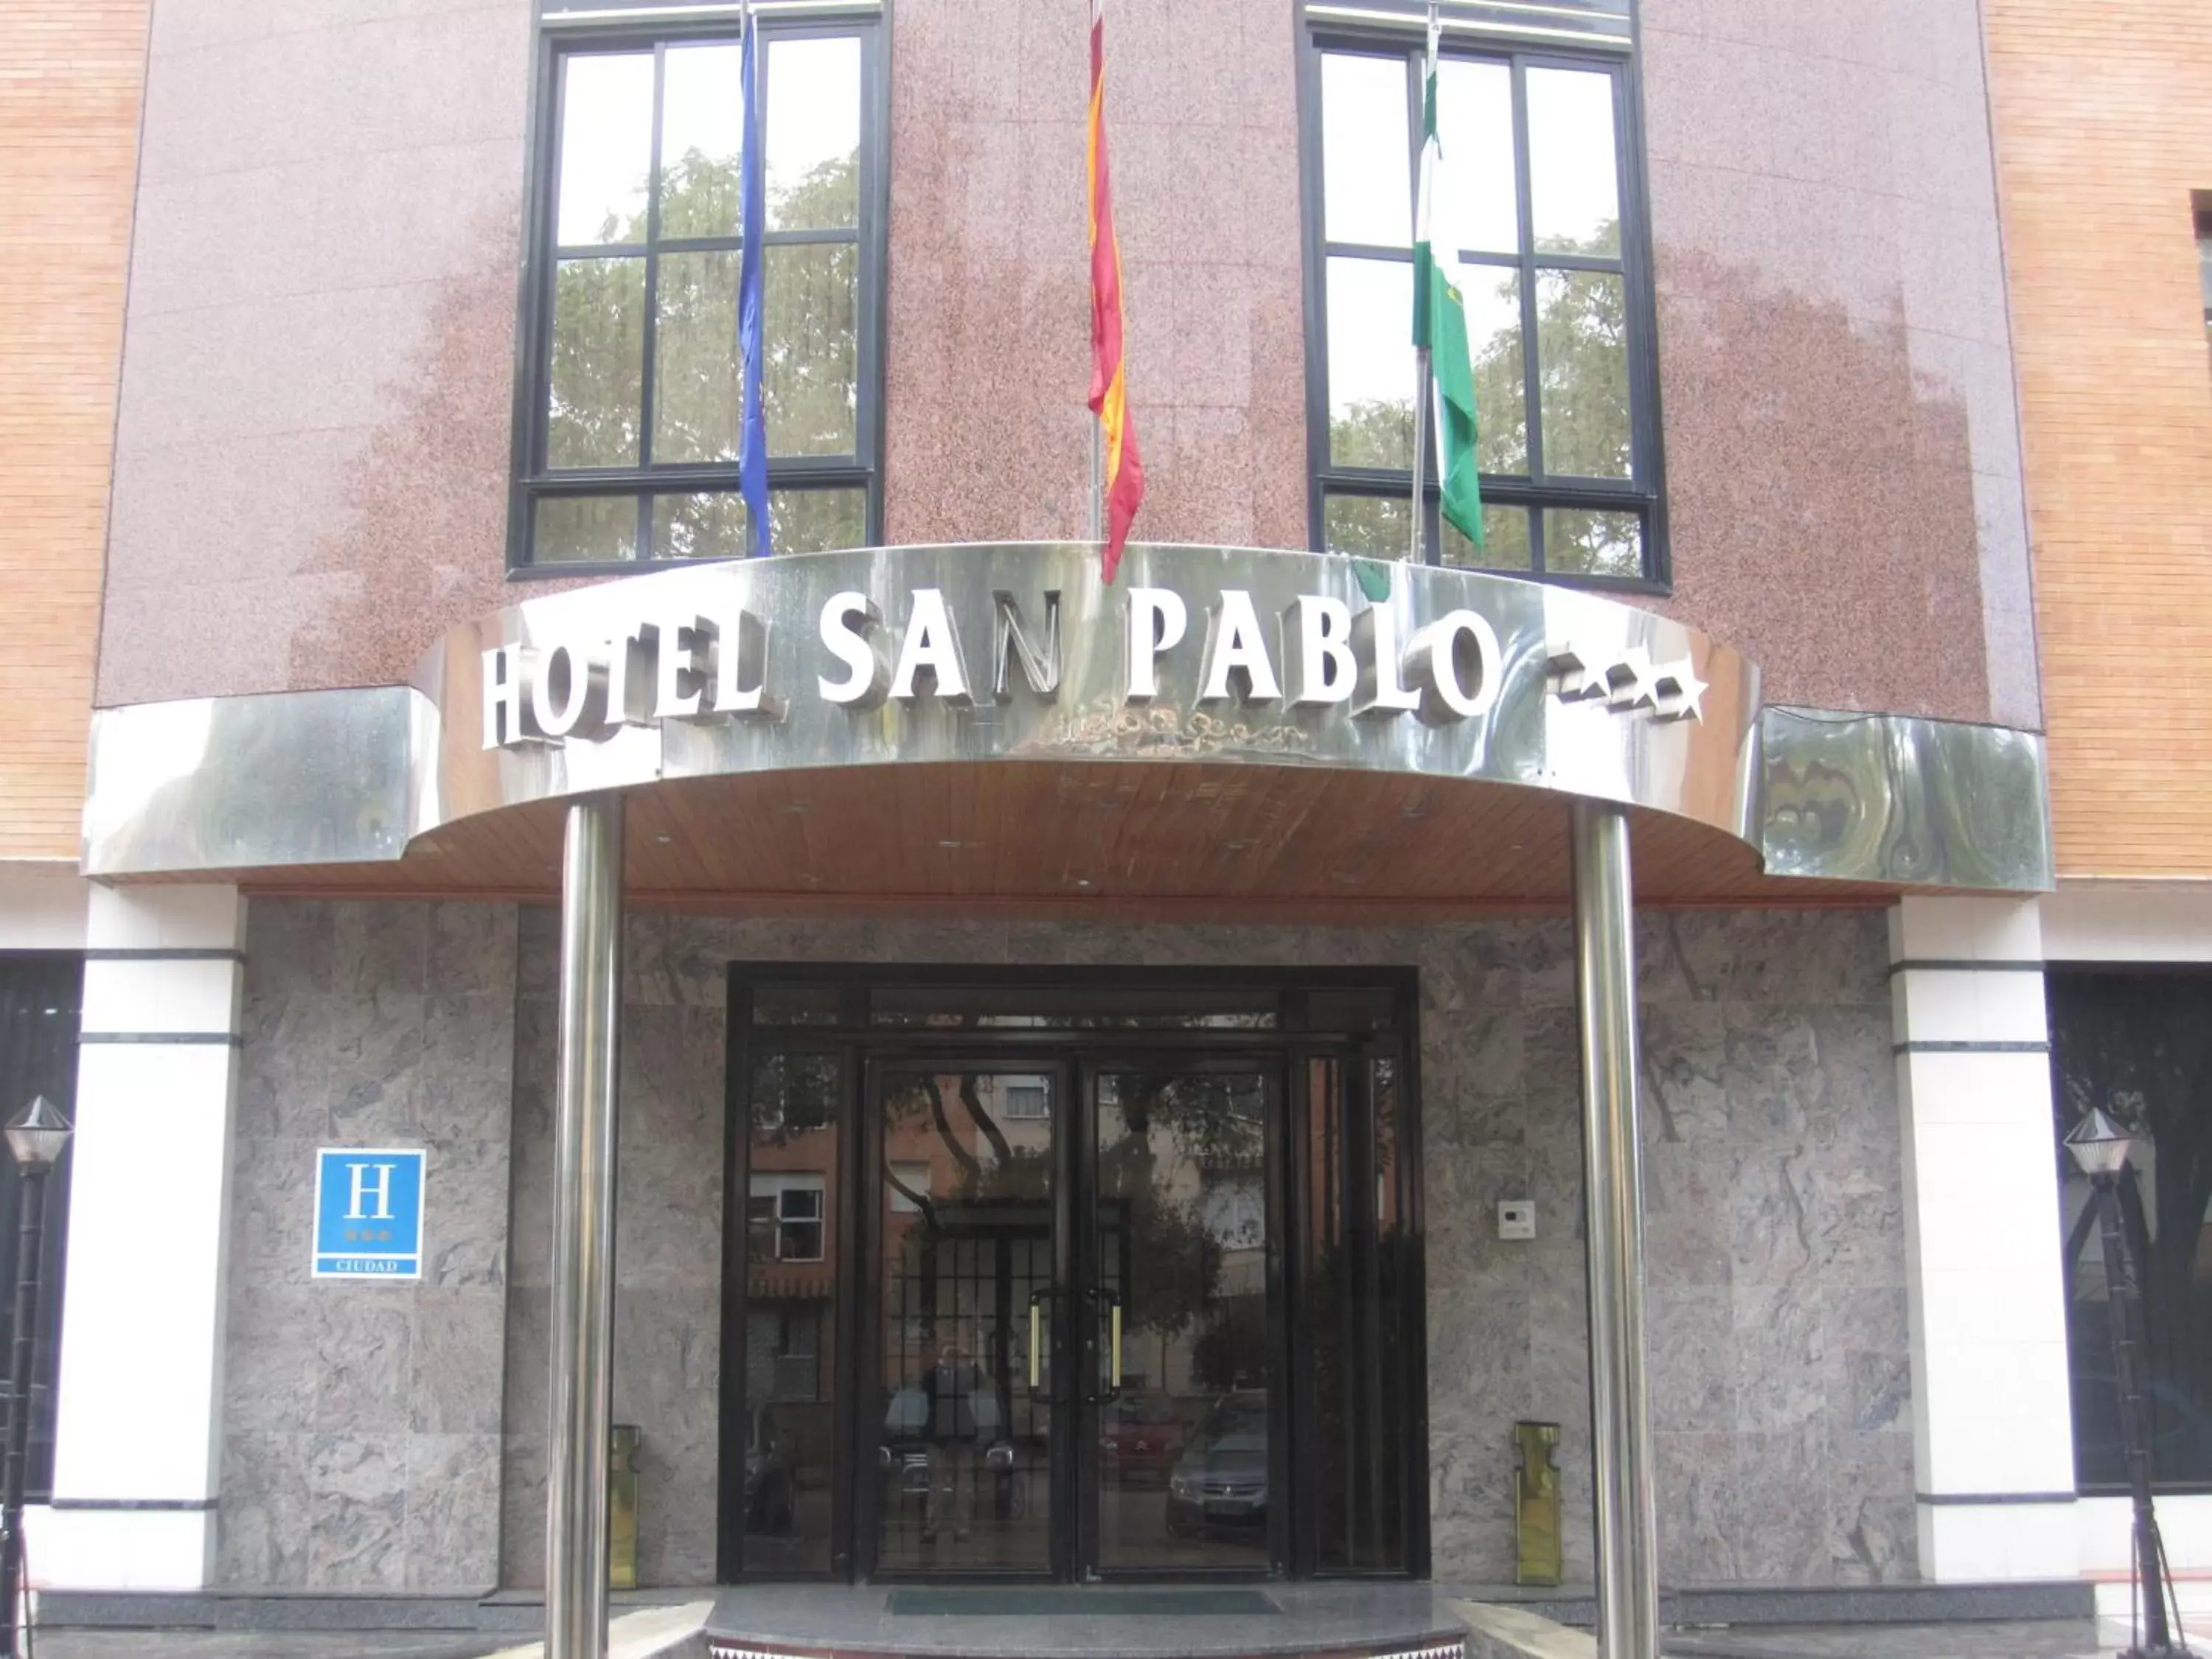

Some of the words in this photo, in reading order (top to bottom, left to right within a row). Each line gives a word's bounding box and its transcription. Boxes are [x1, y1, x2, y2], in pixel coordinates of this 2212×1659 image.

[481, 606, 772, 750] HOTEL
[818, 588, 1062, 706] SAN
[1125, 588, 1502, 718] PABLO
[342, 1164, 397, 1220] H
[335, 1260, 397, 1273] CIUDAD
